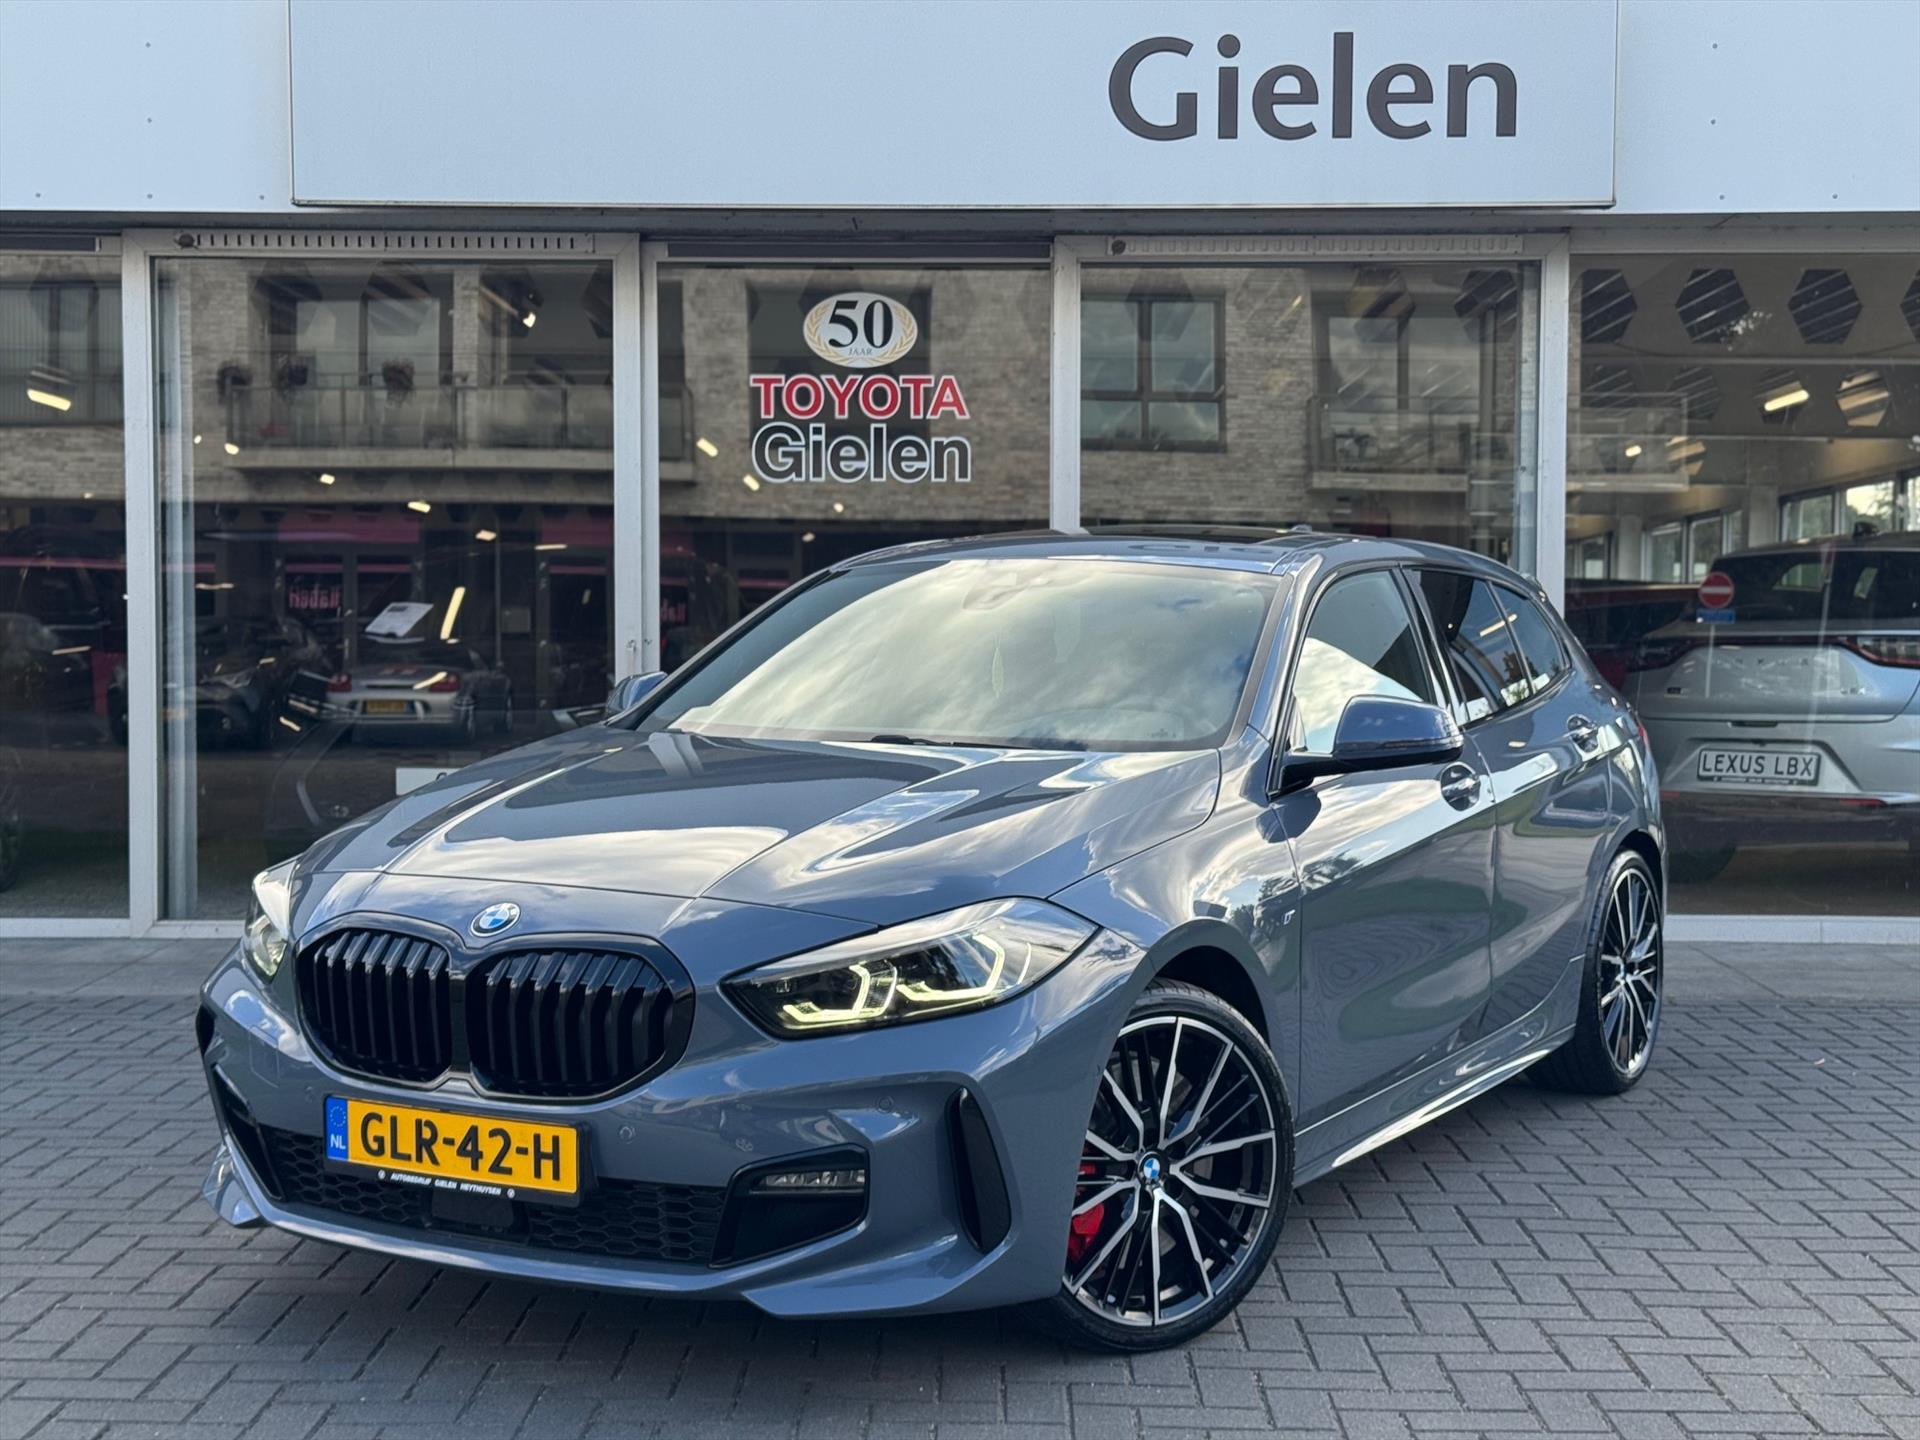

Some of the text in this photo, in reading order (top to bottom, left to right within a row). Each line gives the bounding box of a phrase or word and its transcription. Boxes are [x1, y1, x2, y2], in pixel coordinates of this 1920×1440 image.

[1108, 32, 1518, 142] Gielen
[828, 299, 894, 349] 50
[848, 348, 873, 356] JAAR
[750, 374, 970, 420] TOYOTA
[752, 421, 971, 484] Gielen
[1701, 753, 1814, 777] LEXUS LBX
[330, 1133, 346, 1150] NL
[360, 1111, 561, 1181] GLR-42-H
[434, 1179, 458, 1190] GIELEN
